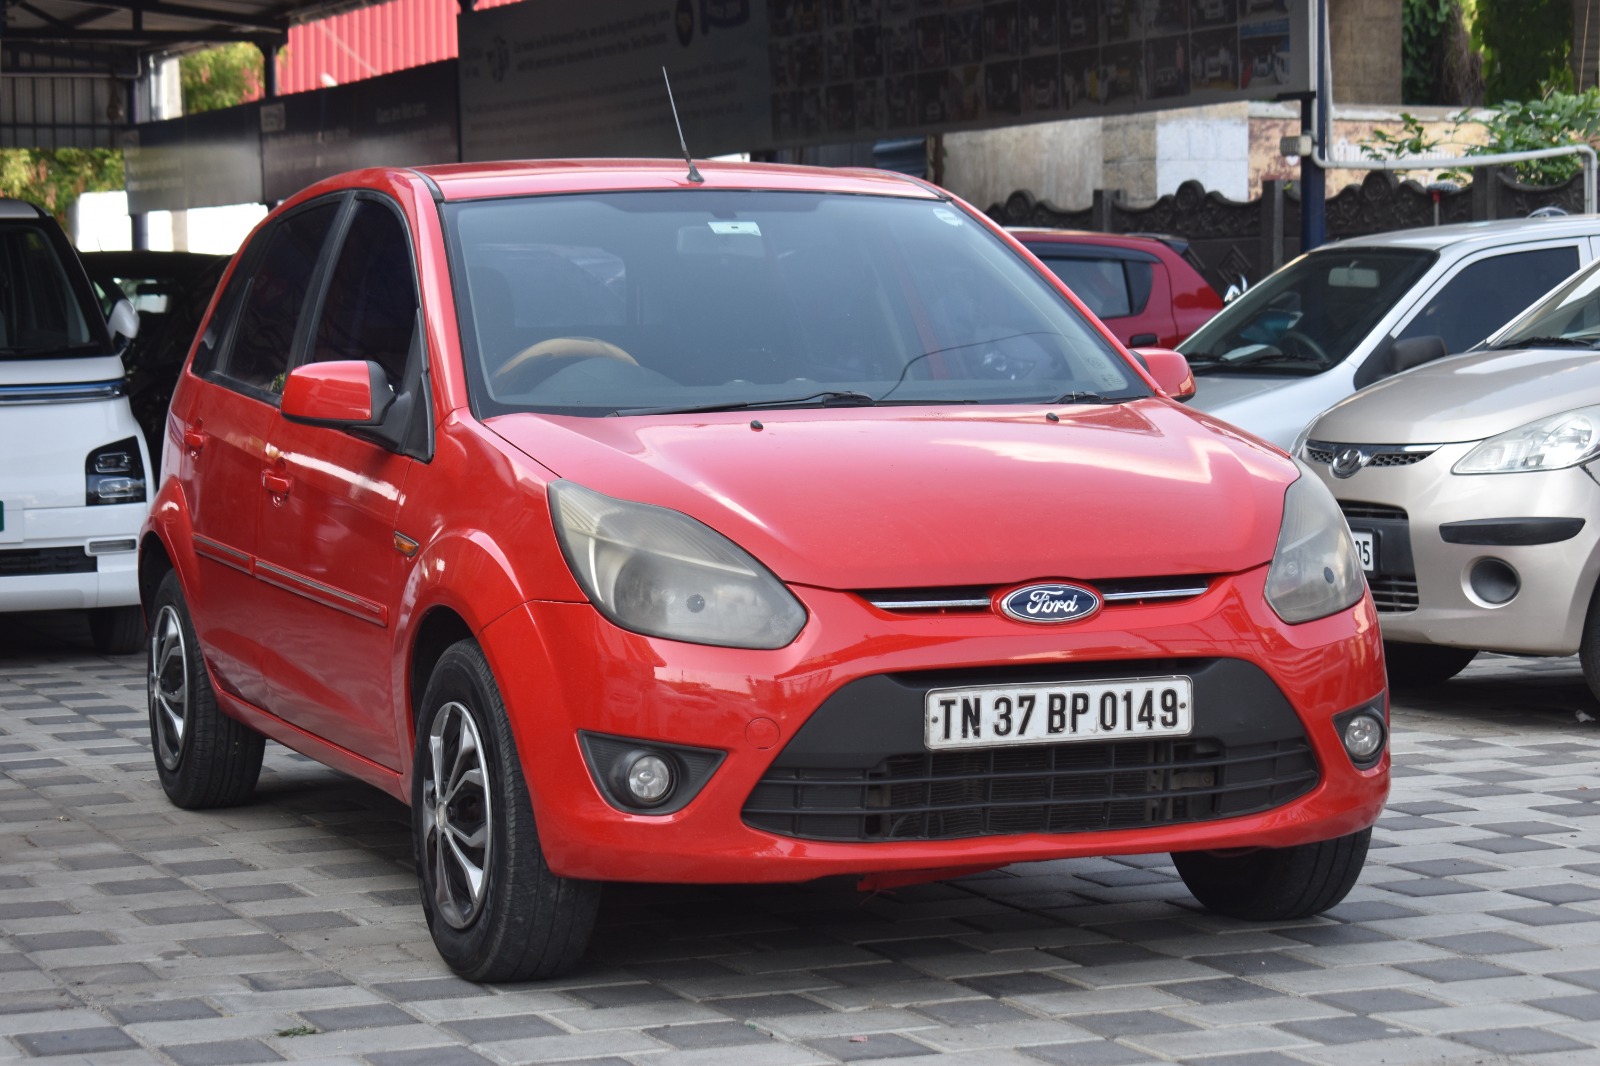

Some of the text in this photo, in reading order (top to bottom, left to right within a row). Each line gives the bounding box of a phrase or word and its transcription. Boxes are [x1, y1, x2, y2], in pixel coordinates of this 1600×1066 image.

[1027, 590, 1078, 614] Ford
[939, 688, 1178, 740] TN 37 BP 0149
